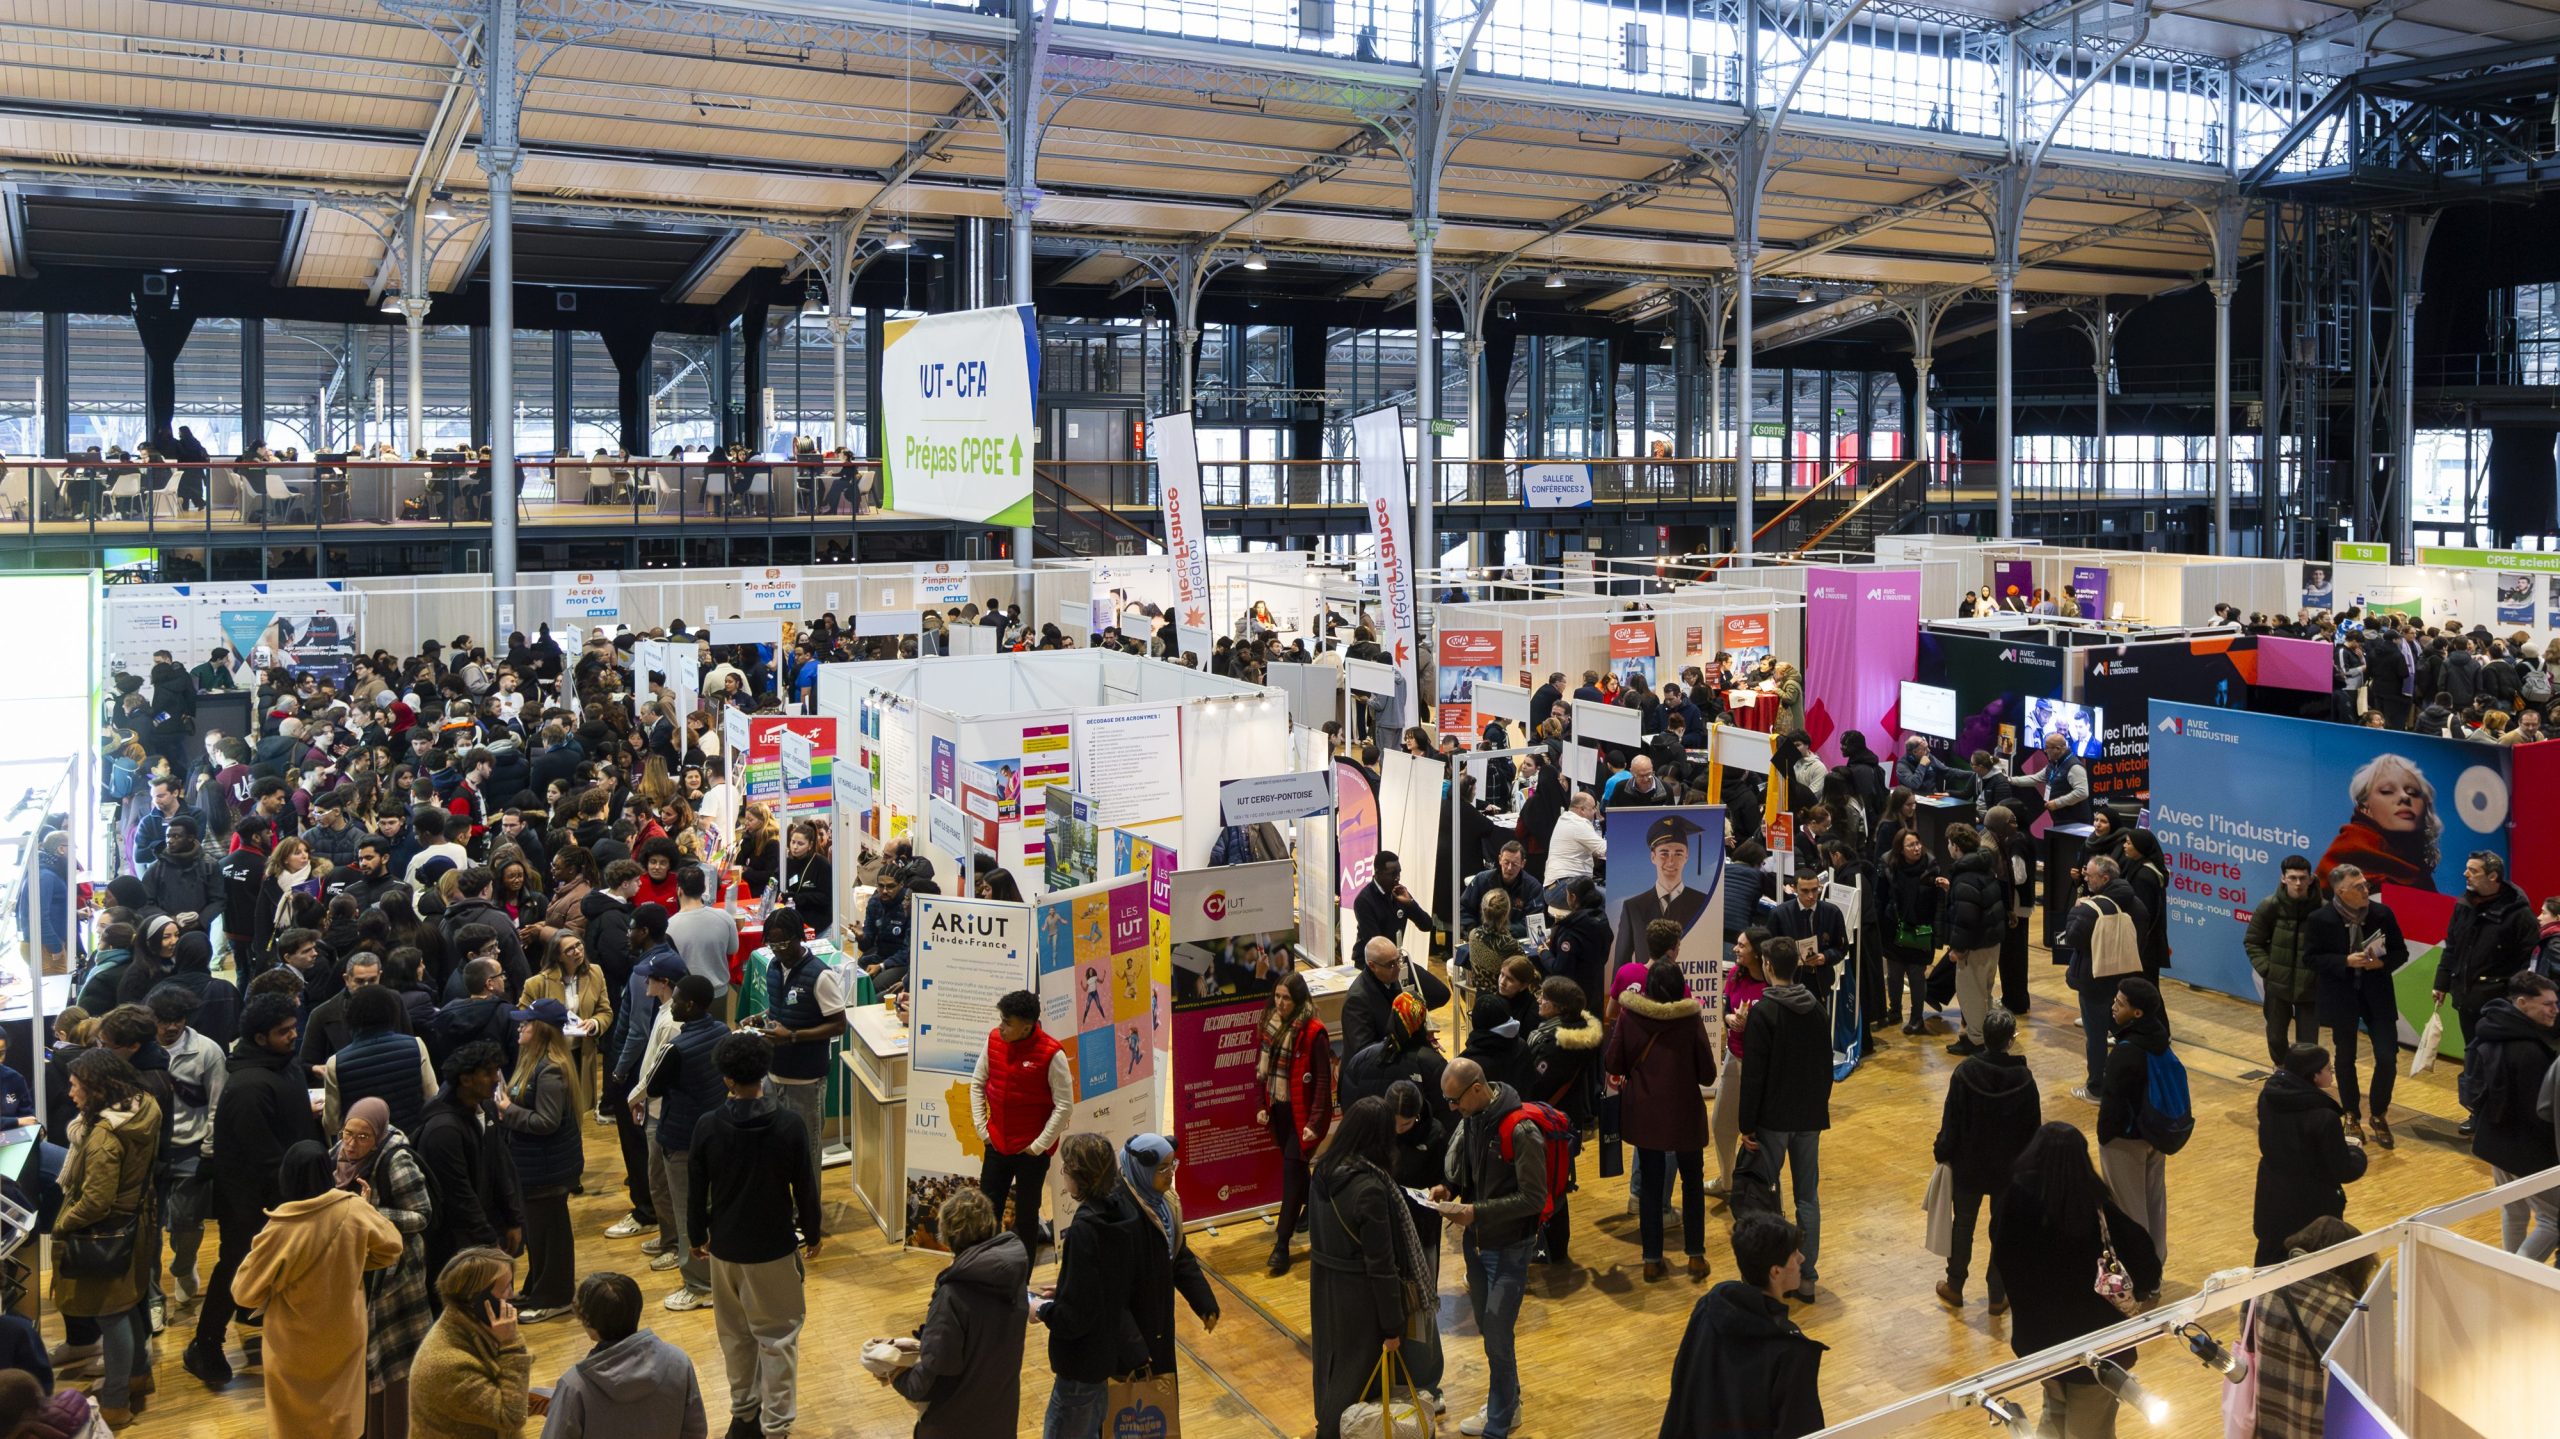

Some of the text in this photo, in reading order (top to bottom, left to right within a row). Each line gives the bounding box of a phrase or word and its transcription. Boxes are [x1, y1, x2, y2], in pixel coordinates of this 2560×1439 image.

[1434, 420, 1456, 435] SORTIE
[1758, 426, 1785, 436] SORTIE
[906, 435, 1005, 479] Prépas CPGE
[1542, 475, 1574, 483] SALLE DE
[1532, 484, 1579, 493] CONFÉRENCES
[1116, 542, 1134, 556] 04
[2356, 549, 2372, 558] TSI
[2487, 555, 2560, 569] CPGE scienti
[568, 587, 604, 596] Je crée
[778, 590, 791, 598] CV
[947, 584, 959, 592] CV
[566, 596, 606, 605] mon CV
[2020, 650, 2035, 658] AVEC
[2019, 658, 2056, 668] L'INDUSTRIE
[2110, 660, 2123, 668] AVEC
[2110, 667, 2139, 676] L'INDUSTRIE
[1126, 714, 1157, 722] ACRONYMES
[2187, 719, 2209, 730] AVEC
[2104, 723, 2149, 741] vec l'indu
[2187, 728, 2240, 744] L'INDUSTRIE
[759, 734, 781, 744] UPE
[2093, 758, 2149, 776] des victoir
[2093, 776, 2142, 793] sur la vie
[1237, 790, 1313, 806] IUT CERGY-PONTOISE
[2157, 804, 2311, 849] Avec l'industrie
[2157, 830, 2270, 864] on fabrique
[2164, 852, 2242, 881] a liberté
[1157, 868, 1169, 880] LES
[1154, 880, 1170, 900] IUT
[2170, 873, 2247, 905] 'être soi
[1228, 898, 1245, 909] IUT
[1121, 906, 1138, 919] LES
[1117, 918, 1143, 938] IUT
[1678, 960, 1718, 975] VENIR
[1218, 1030, 1254, 1049] EXIGENCE
[1215, 1049, 1258, 1069] INNOVATION
[920, 1102, 936, 1111] LES
[916, 1113, 940, 1129] IUT
